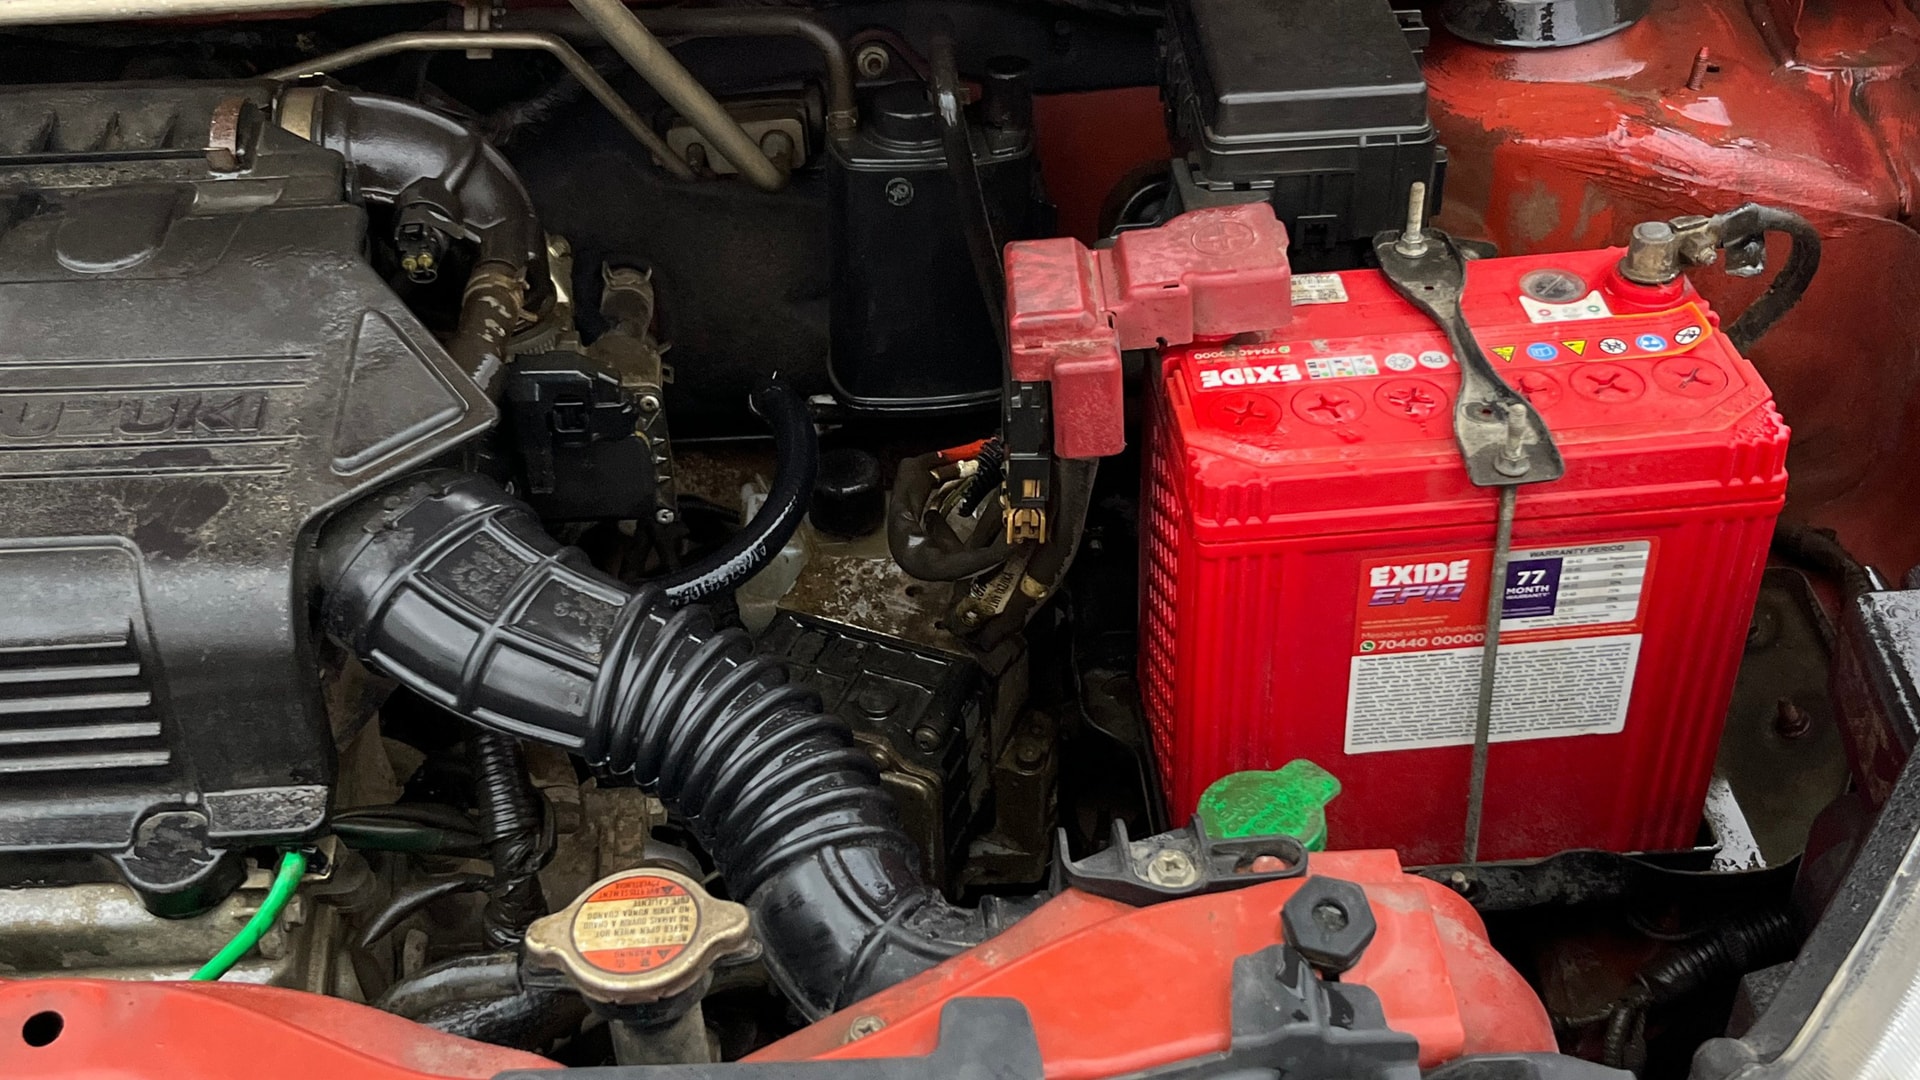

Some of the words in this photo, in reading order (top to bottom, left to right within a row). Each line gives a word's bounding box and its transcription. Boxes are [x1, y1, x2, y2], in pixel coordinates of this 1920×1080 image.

[1199, 363, 1302, 388] EXIDE
[0, 391, 268, 438] UZUKI
[1530, 548, 1585, 558] WARRANTY
[1587, 545, 1625, 553] PERIOD
[1369, 559, 1471, 588] EXIDE
[1517, 570, 1546, 586] 77
[1368, 582, 1467, 607] EPIQ
[1506, 585, 1550, 595] MONTH
[1361, 630, 1405, 640] Message
[1405, 629, 1416, 637] us
[1377, 637, 1428, 650] 70440
[1431, 633, 1485, 646] 00000
[613, 928, 636, 937] WHEN
[640, 926, 661, 935] OPEN
